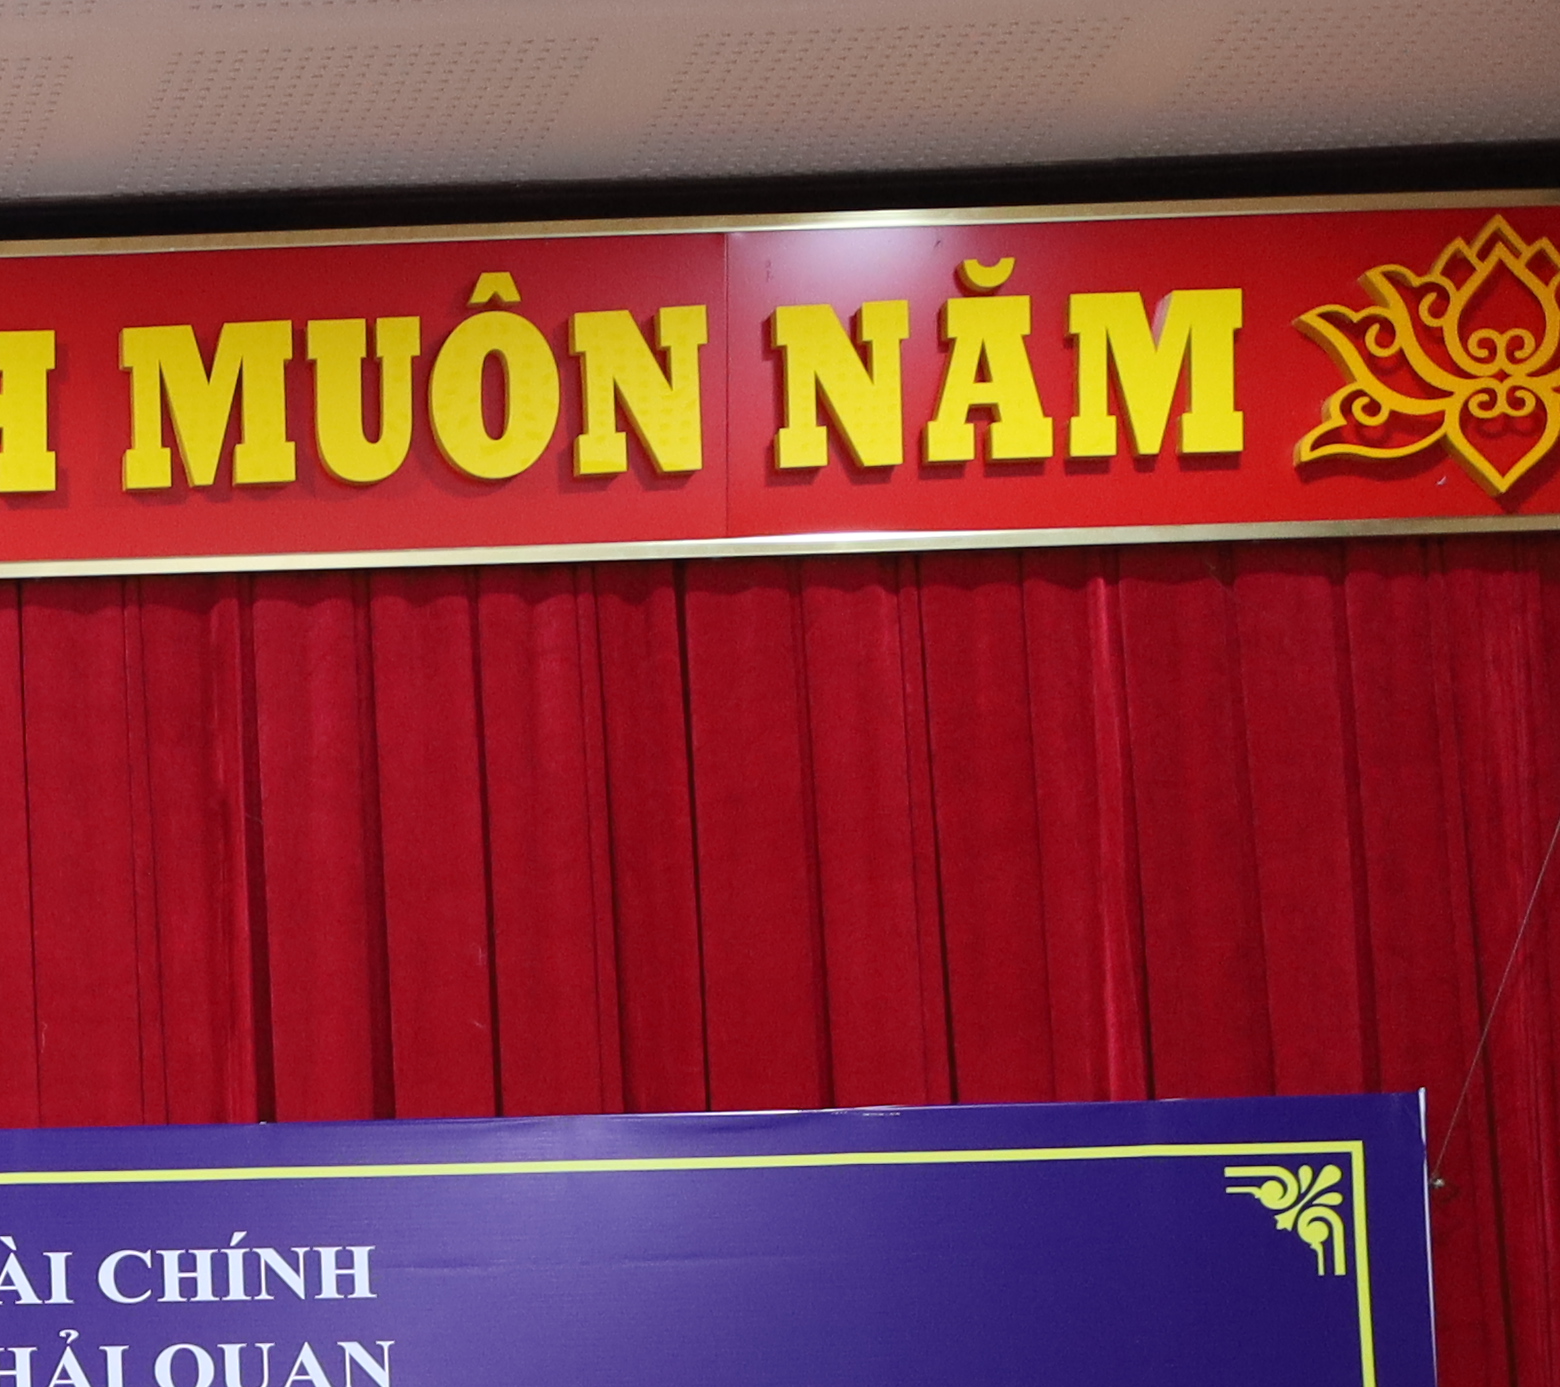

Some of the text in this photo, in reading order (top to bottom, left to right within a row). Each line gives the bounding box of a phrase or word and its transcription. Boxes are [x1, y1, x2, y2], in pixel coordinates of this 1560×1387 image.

[123, 272, 708, 489] MUÔN
[776, 257, 1244, 468] NĂM
[98, 1231, 378, 1304] CHÍNH
